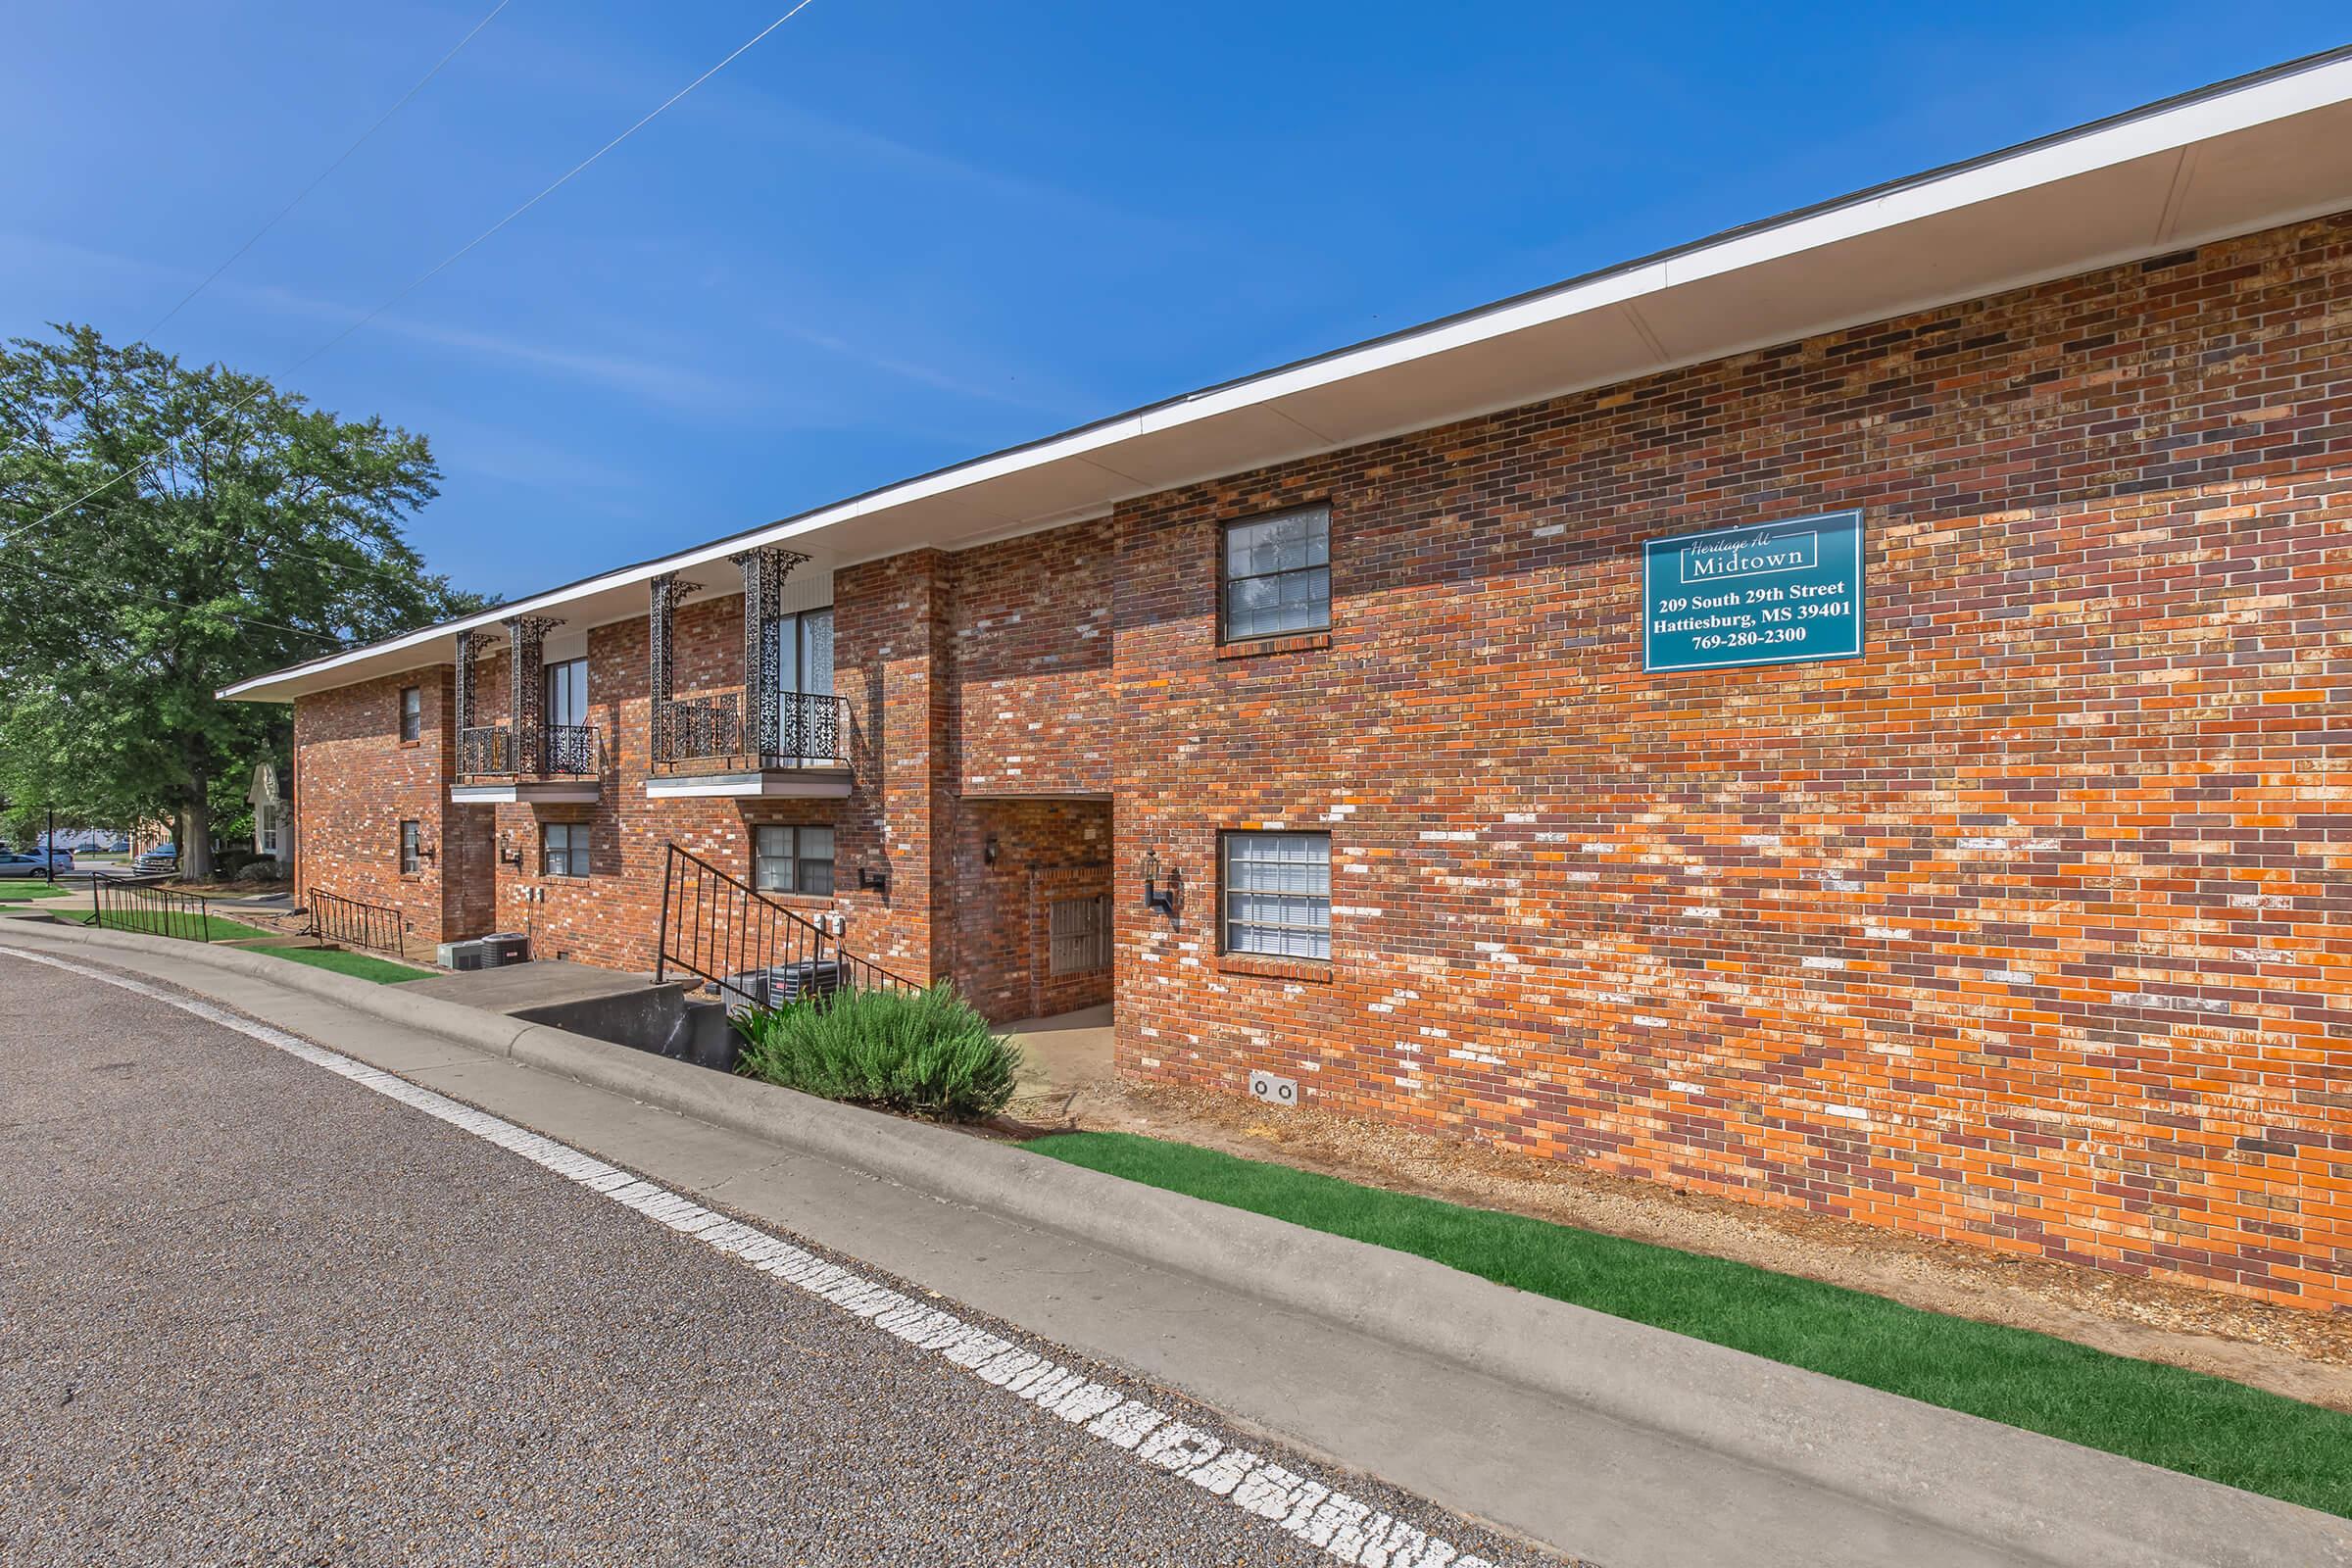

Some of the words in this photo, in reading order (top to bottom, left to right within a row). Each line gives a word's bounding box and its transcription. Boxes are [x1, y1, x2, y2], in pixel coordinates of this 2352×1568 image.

[1690, 538, 1747, 556] Heritage
[1751, 531, 1771, 546] At
[1692, 549, 1803, 576] Midtown
[1658, 598, 1687, 612] 209
[1691, 590, 1740, 610] South
[1745, 587, 1784, 603] 29th
[1789, 580, 1844, 599] Street
[1653, 614, 1756, 634] Hattiesburg,
[1761, 607, 1792, 623] MS
[1797, 601, 1850, 619] 39401
[1691, 626, 1806, 650] 769-280-2300
